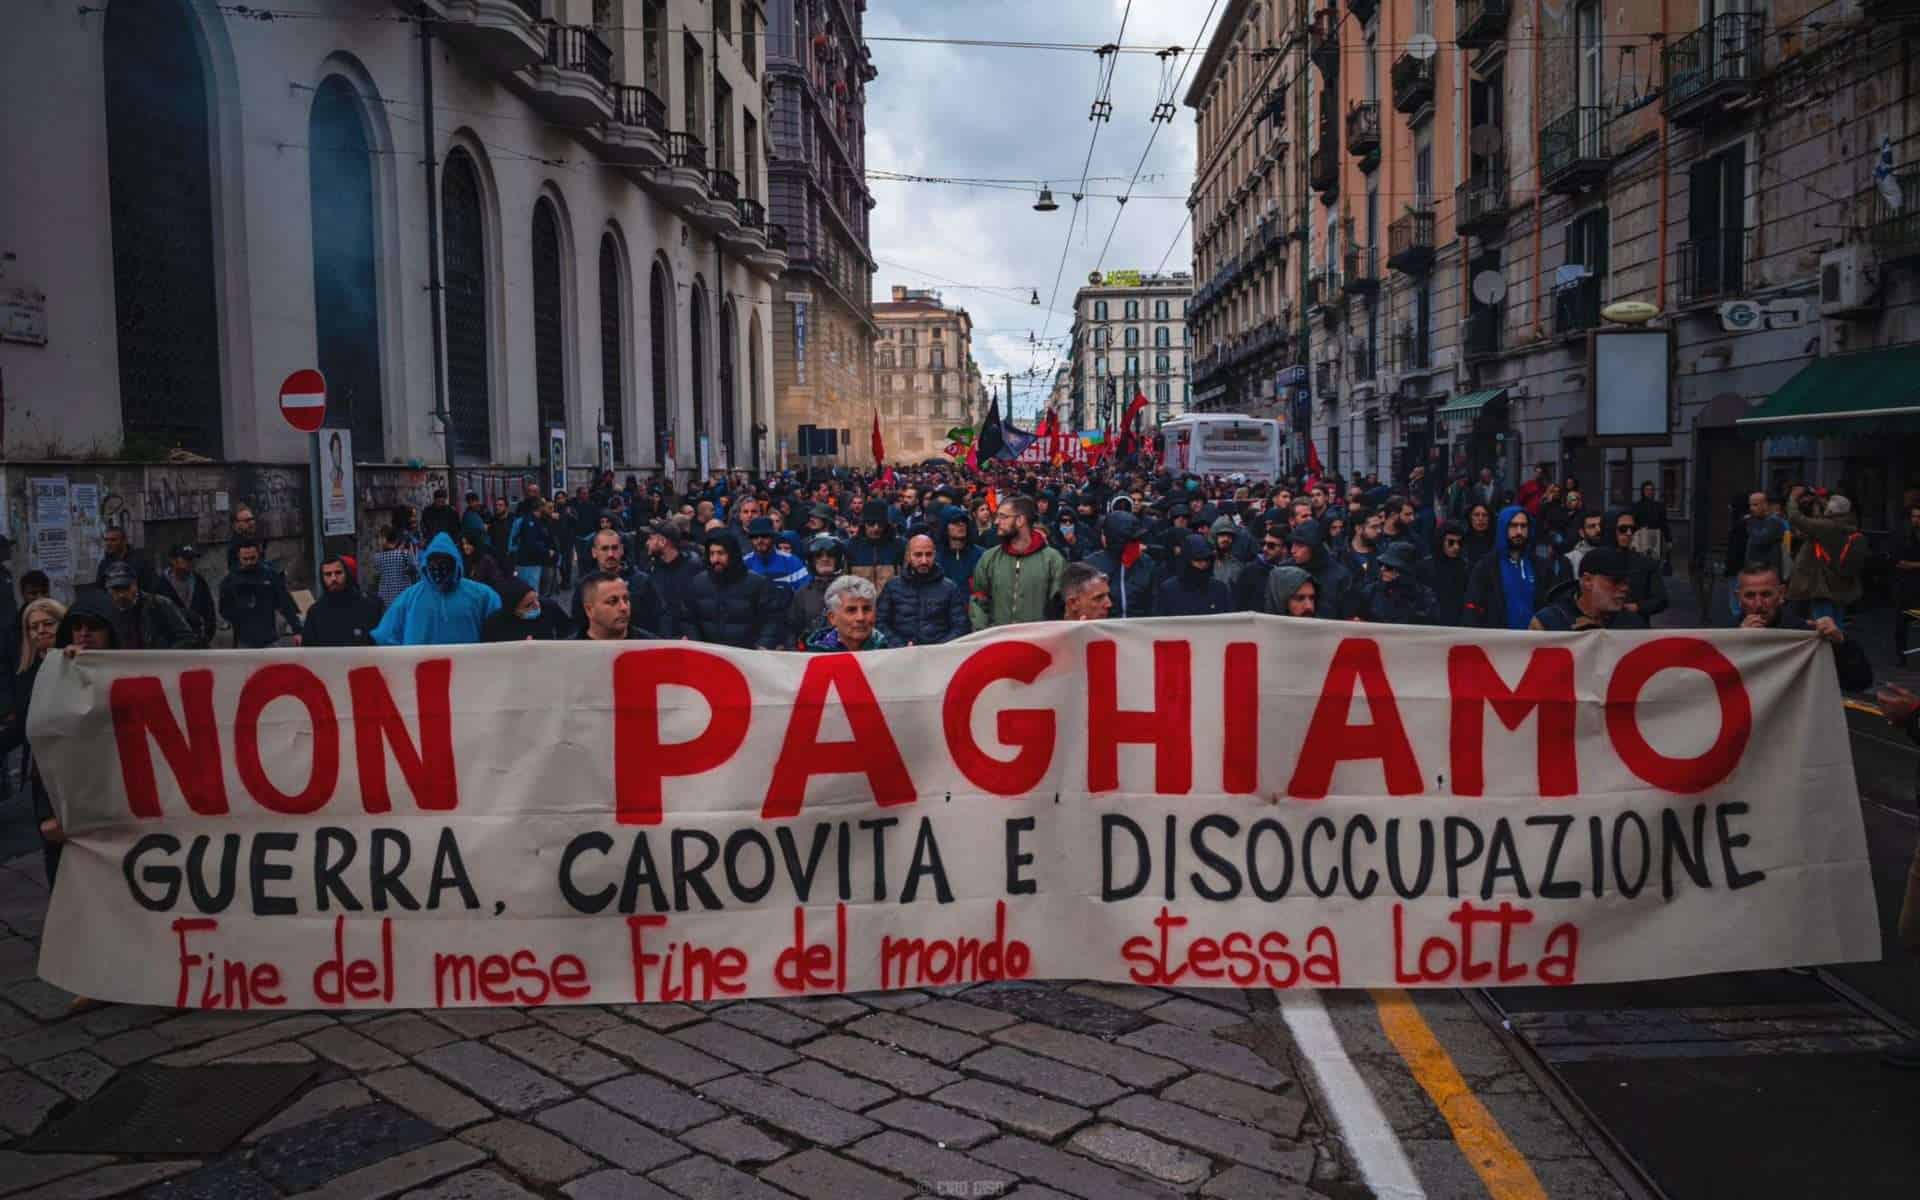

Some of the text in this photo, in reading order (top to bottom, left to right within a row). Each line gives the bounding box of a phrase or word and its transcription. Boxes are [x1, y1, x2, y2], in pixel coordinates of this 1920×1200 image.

[111, 635, 1753, 829] NON PAGHIAMO
[122, 801, 1766, 916] GUERRA, CAROVITA E DISOCCUPAZIONE
[173, 917, 287, 1010] Fine
[314, 914, 395, 1007] del
[434, 948, 592, 1010] mese
[625, 913, 750, 1004] Fine
[772, 902, 848, 996] del
[880, 899, 1035, 992] mondo
[1120, 906, 1342, 990] stessa
